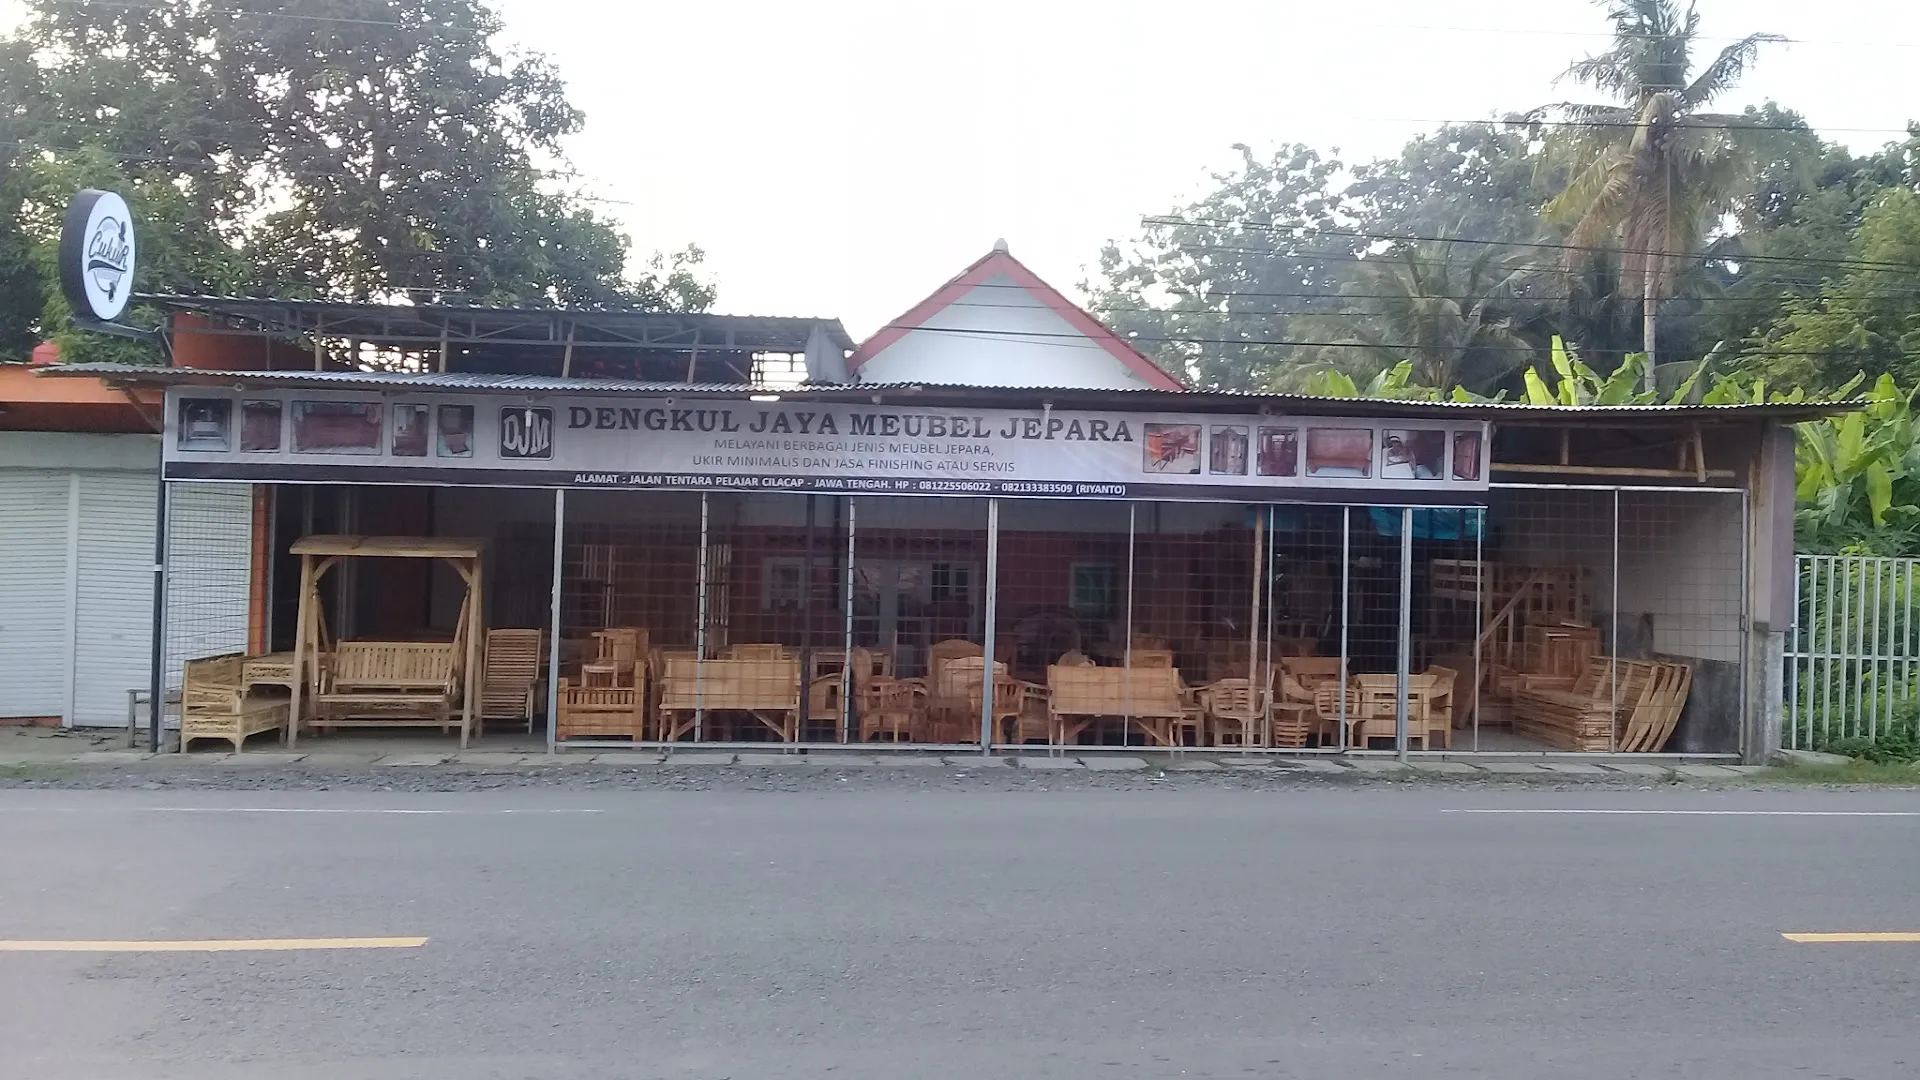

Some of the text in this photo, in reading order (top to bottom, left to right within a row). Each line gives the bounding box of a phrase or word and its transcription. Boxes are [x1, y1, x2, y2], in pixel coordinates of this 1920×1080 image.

[503, 410, 550, 456] DJM
[568, 406, 1134, 442] DENGKUL JAYA MEUBEL JEPARA
[714, 439, 995, 457] MELAYANI BERBAGAI JENIS MEUBEL JEPARA,
[693, 455, 723, 466] UKIR
[803, 457, 830, 468] DAN
[834, 458, 864, 469] JASA
[868, 459, 933, 470] FINISHING
[936, 460, 969, 472] ATAU
[972, 461, 1015, 472] SERVIS
[574, 474, 619, 484] ALAMAT
[629, 475, 662, 485] JALAN
[665, 475, 713, 485] TENTARA
[716, 477, 759, 487] PELAJAR
[762, 477, 804, 487] CILACAP
[814, 479, 843, 488] JAWA
[847, 479, 891, 490] TENGAH.
[895, 481, 909, 490] HP
[919, 481, 991, 491] 081225506022
[1001, 483, 1073, 493] 082133383509
[1076, 484, 1126, 496] (RIYANTO)
